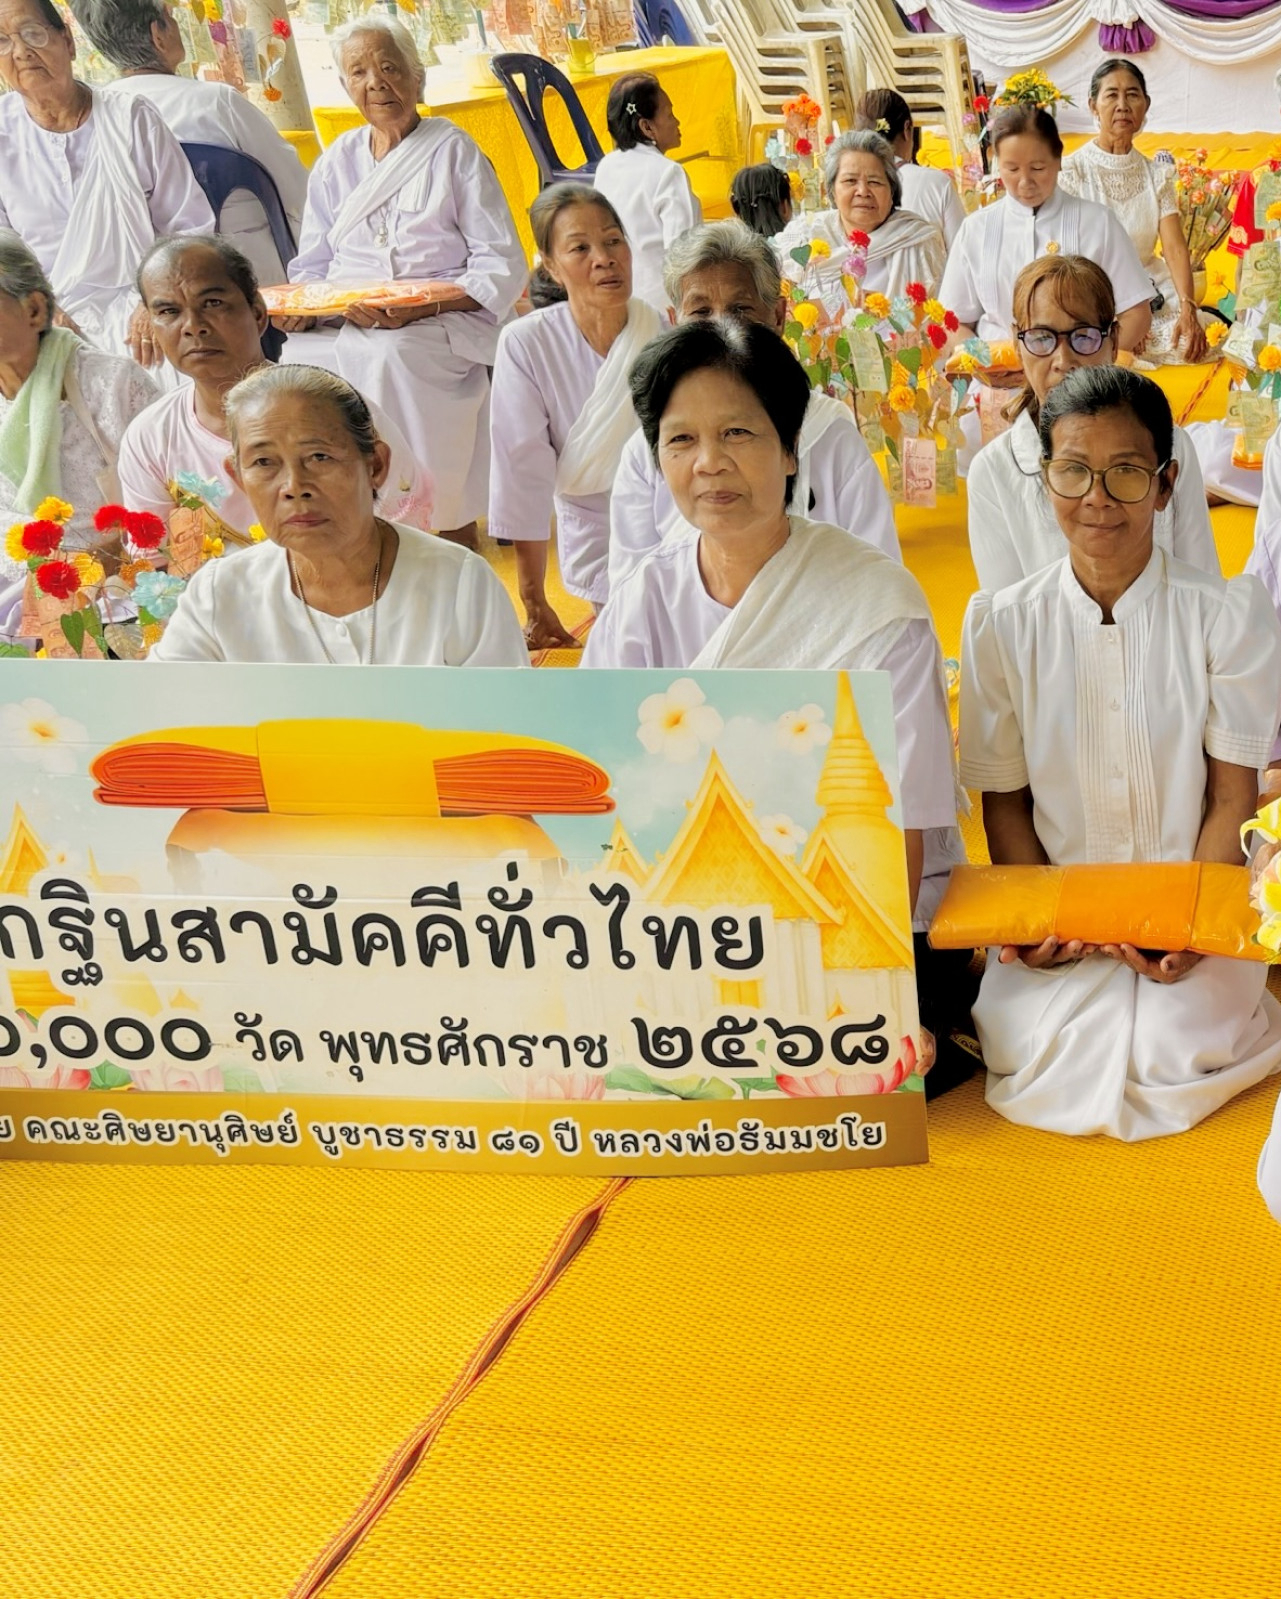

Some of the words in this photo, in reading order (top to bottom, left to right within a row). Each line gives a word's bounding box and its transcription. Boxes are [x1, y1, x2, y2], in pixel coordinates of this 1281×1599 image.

[0, 861, 765, 986] กฐินสามัคคีทั่วไทย
[233, 1011, 304, 1062] วัด
[319, 1015, 609, 1082] พุทธศักราช
[630, 1013, 890, 1068] ๒๕๖๘
[27, 1112, 299, 1153] คณะศิษยานุศิษย์
[313, 1123, 477, 1155] บูชาธรรม
[491, 1128, 541, 1153] ๘๑
[553, 1122, 578, 1151] ปี
[594, 1117, 884, 1152] หลวงพ่อธัมมชโย
